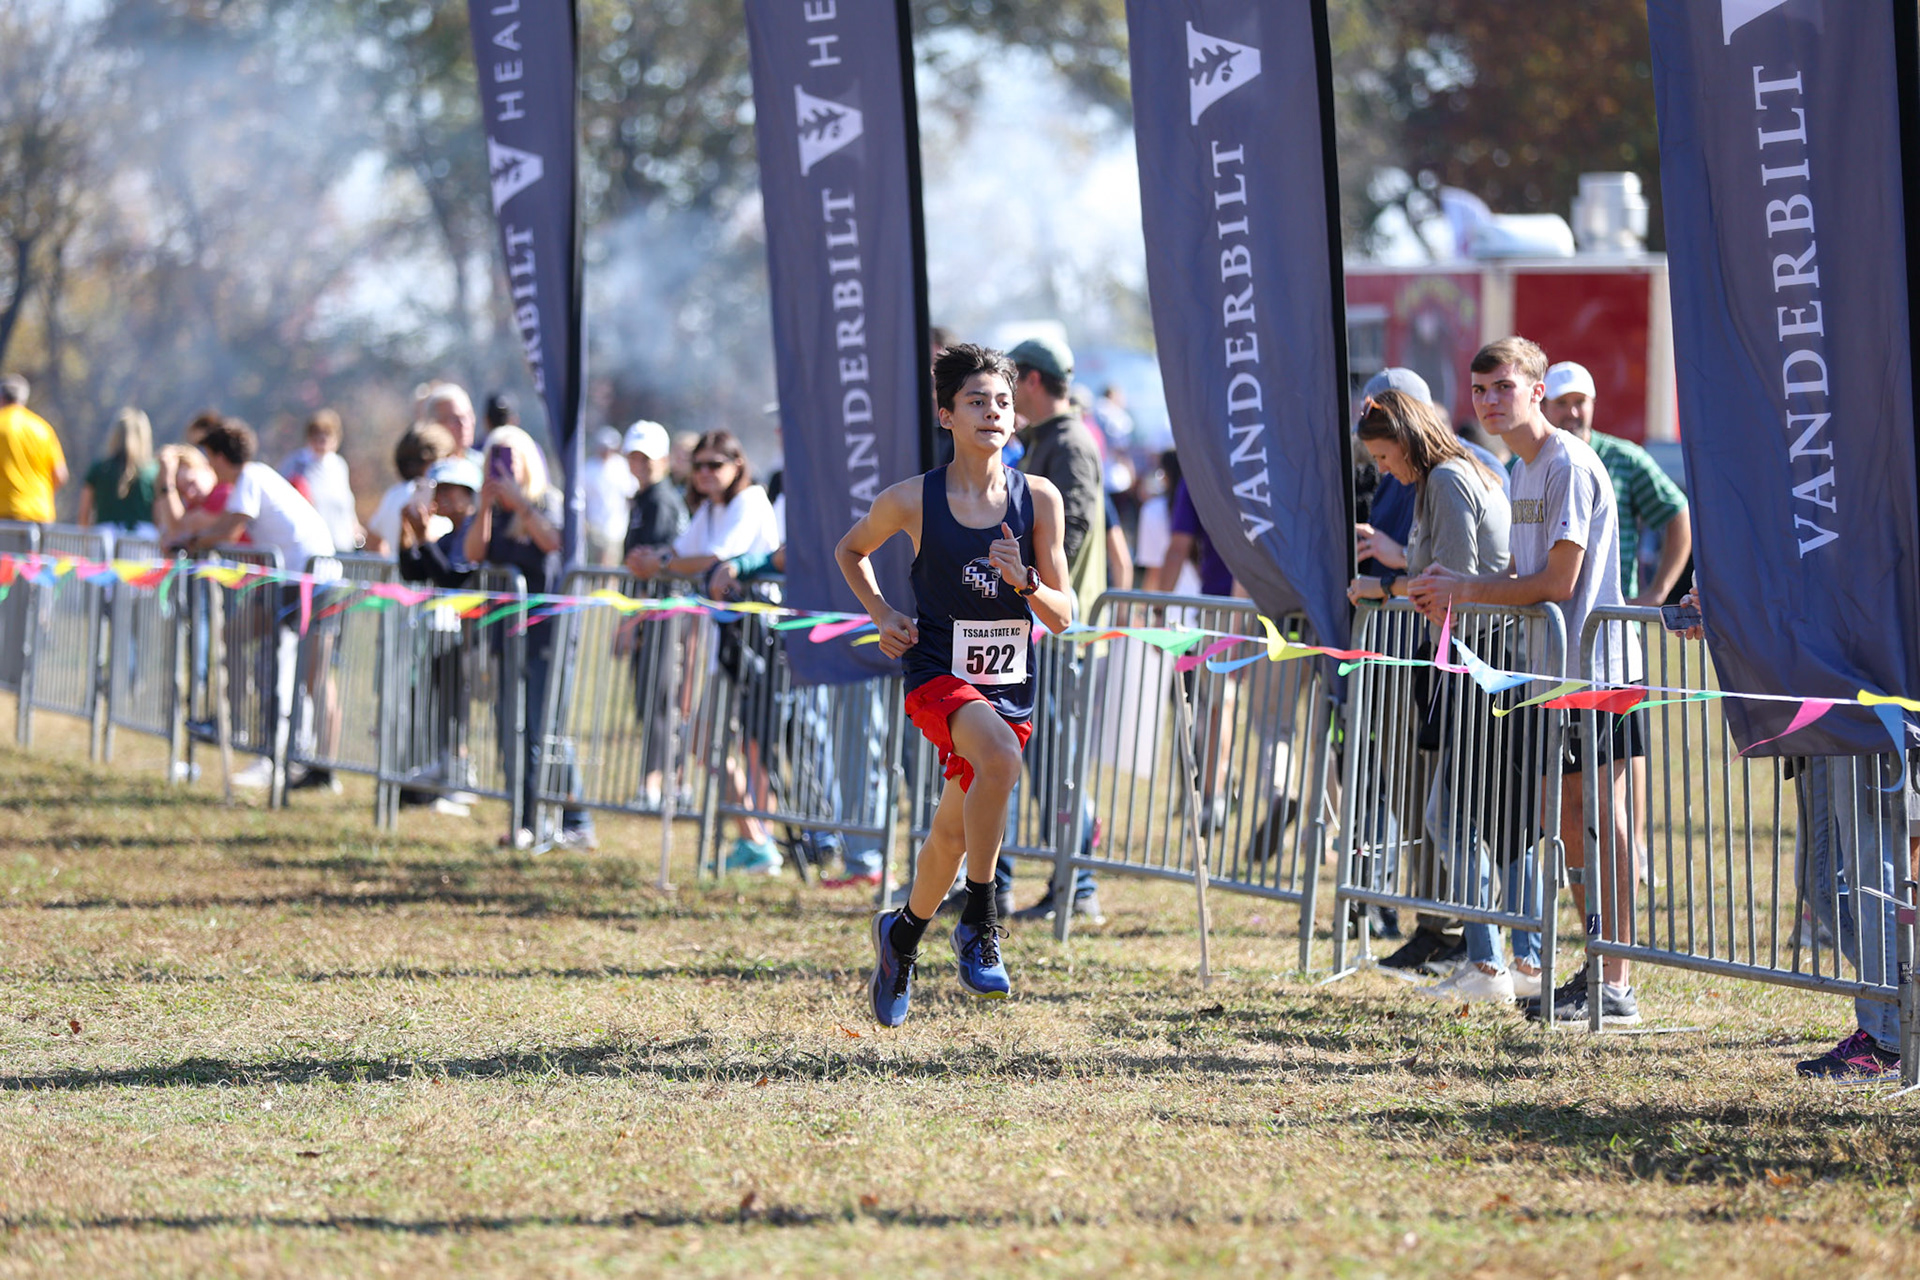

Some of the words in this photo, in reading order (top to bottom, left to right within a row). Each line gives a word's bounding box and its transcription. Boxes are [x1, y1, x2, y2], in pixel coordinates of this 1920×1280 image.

[491, 0, 526, 121] HEAL
[804, 0, 841, 67] HE
[1211, 140, 1275, 546] VANDERBILT
[1753, 65, 1839, 559] VANDERBILT
[964, 566, 997, 597] SBA
[963, 628, 989, 638] TSSAA
[990, 628, 1010, 637] STATE
[1010, 627, 1021, 636] XC
[966, 644, 1016, 675] 522
